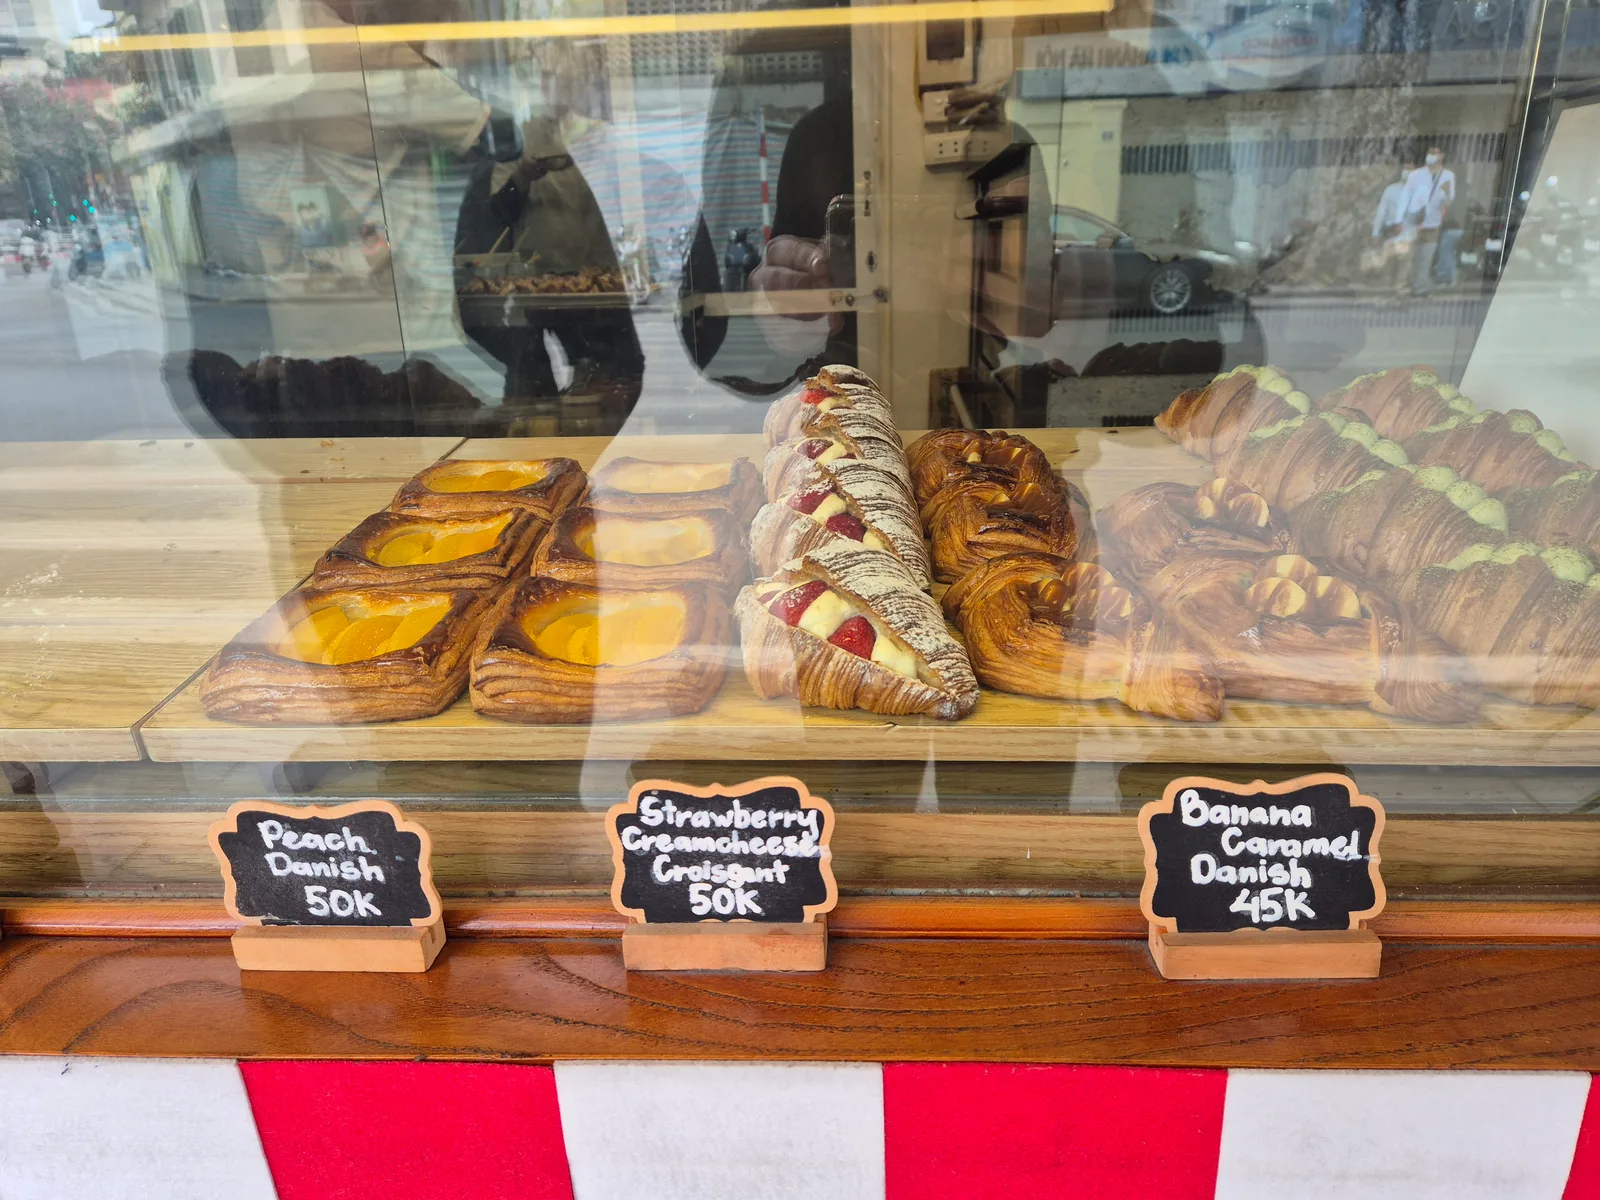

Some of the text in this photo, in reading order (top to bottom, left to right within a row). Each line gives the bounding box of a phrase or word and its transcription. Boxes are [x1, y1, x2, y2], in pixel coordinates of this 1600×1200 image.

[640, 796, 820, 841] Strawberry
[1180, 788, 1313, 827] Banana
[256, 819, 377, 855] Peach
[621, 825, 820, 857] Creamcheese
[1221, 826, 1361, 860] Caramel
[264, 851, 386, 884] Danish
[1190, 852, 1312, 889] Danish
[303, 885, 382, 918] 50K
[688, 882, 764, 916] 50K
[1229, 886, 1316, 924] 45K
